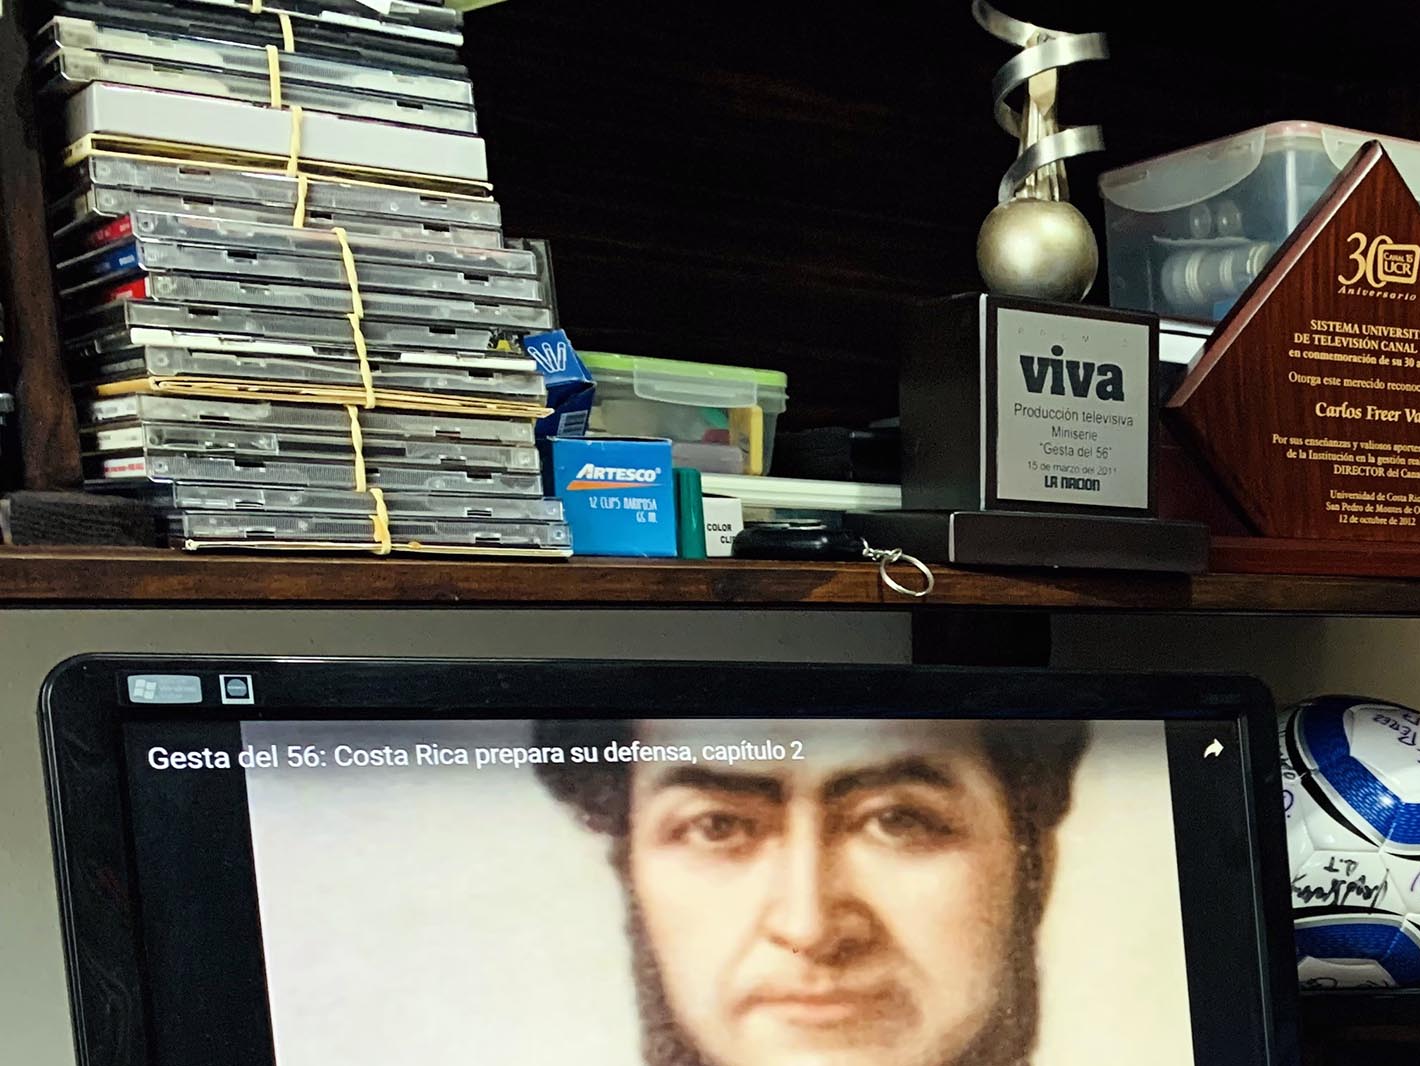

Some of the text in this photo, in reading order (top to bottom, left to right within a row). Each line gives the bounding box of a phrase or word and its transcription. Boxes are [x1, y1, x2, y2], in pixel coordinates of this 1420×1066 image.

[1384, 261, 1411, 275] UCR
[1338, 286, 1417, 300] Aniversario
[1310, 320, 1359, 334] SISTEMA
[1294, 333, 1310, 344] DE
[1312, 334, 1378, 350] TELEVISIÓN
[1381, 341, 1417, 353] CANAL
[1289, 349, 1301, 358] en
[1303, 351, 1377, 364] conmemoración
[1379, 355, 1389, 365] de
[1392, 358, 1402, 366] su
[1405, 357, 1414, 367] 30
[1020, 345, 1124, 401] viva
[1289, 371, 1321, 386] Otorga
[1323, 376, 1341, 386] este
[1344, 377, 1385, 389] merecido
[1014, 403, 1133, 426] Producción televisiva
[1315, 402, 1362, 419] Carlos
[1365, 405, 1401, 422] Freer
[1052, 426, 1097, 441] Miniserie
[1273, 434, 1287, 445] Por
[1290, 437, 1303, 446] sus
[1305, 437, 1350, 448] enseñanzas
[1353, 441, 1358, 450] y
[1360, 440, 1391, 451] valiosos
[1393, 443, 1420, 453] aportes
[1078, 447, 1093, 457] del
[1287, 449, 1297, 458] de
[1299, 450, 1306, 459] la
[1309, 450, 1353, 462] Institución
[1356, 455, 1365, 463] en
[1368, 453, 1375, 463] la
[1377, 455, 1405, 465] gestión
[1028, 461, 1038, 470] 15
[1041, 462, 1050, 471] de
[1053, 464, 1079, 473] marzo
[1334, 465, 1385, 477] DIRECTOR
[1387, 468, 1399, 478] del
[1044, 476, 1057, 488] LA
[589, 496, 597, 509] 12
[600, 497, 620, 510] CLIPS
[1330, 490, 1375, 501] Universidad
[1377, 492, 1386, 501] de
[1387, 493, 1406, 502] Costa
[1326, 502, 1340, 511] San
[1342, 503, 1363, 513] Pedro
[1365, 503, 1374, 513] de
[1376, 504, 1402, 514] Montes
[1404, 505, 1413, 514] de
[1339, 515, 1416, 526] 12 de octubre de 2012
[148, 740, 804, 769] Gesta del 56: Costa Rica prepara su defensa, capítulo 2
